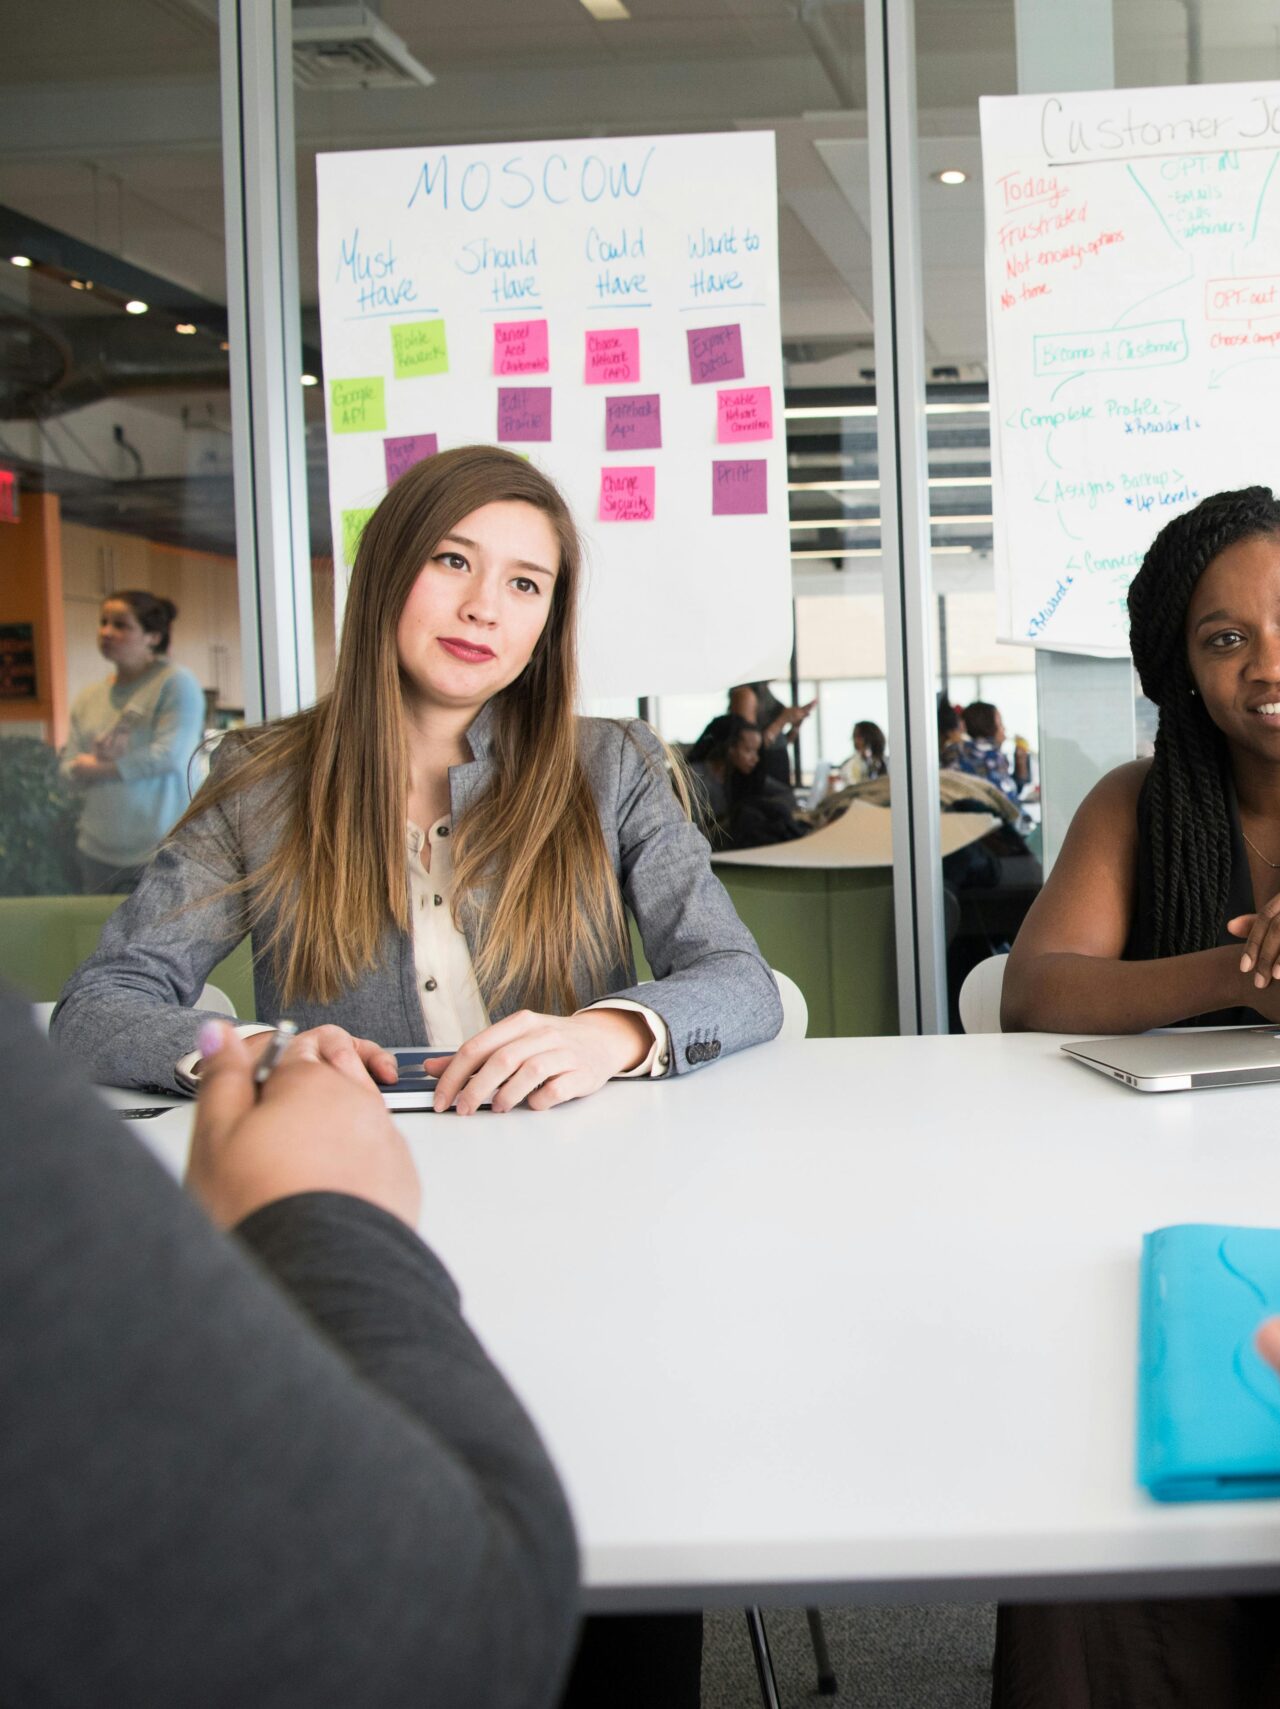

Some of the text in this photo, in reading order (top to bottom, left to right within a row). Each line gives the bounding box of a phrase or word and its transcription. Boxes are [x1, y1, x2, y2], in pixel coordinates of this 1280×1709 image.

[1041, 97, 1233, 157] Customer
[407, 147, 655, 212] MOSCOW
[995, 170, 1061, 208] Today
[585, 225, 646, 263] Could
[687, 224, 760, 259] Want to
[998, 200, 1088, 253] Frustrated
[336, 226, 397, 283] Must
[455, 236, 538, 275] Should
[1006, 252, 1030, 279] Not
[357, 277, 418, 310] Have
[491, 272, 541, 303] Have
[596, 268, 649, 298] Have
[690, 267, 743, 297] Have
[1105, 398, 1161, 417] Profile
